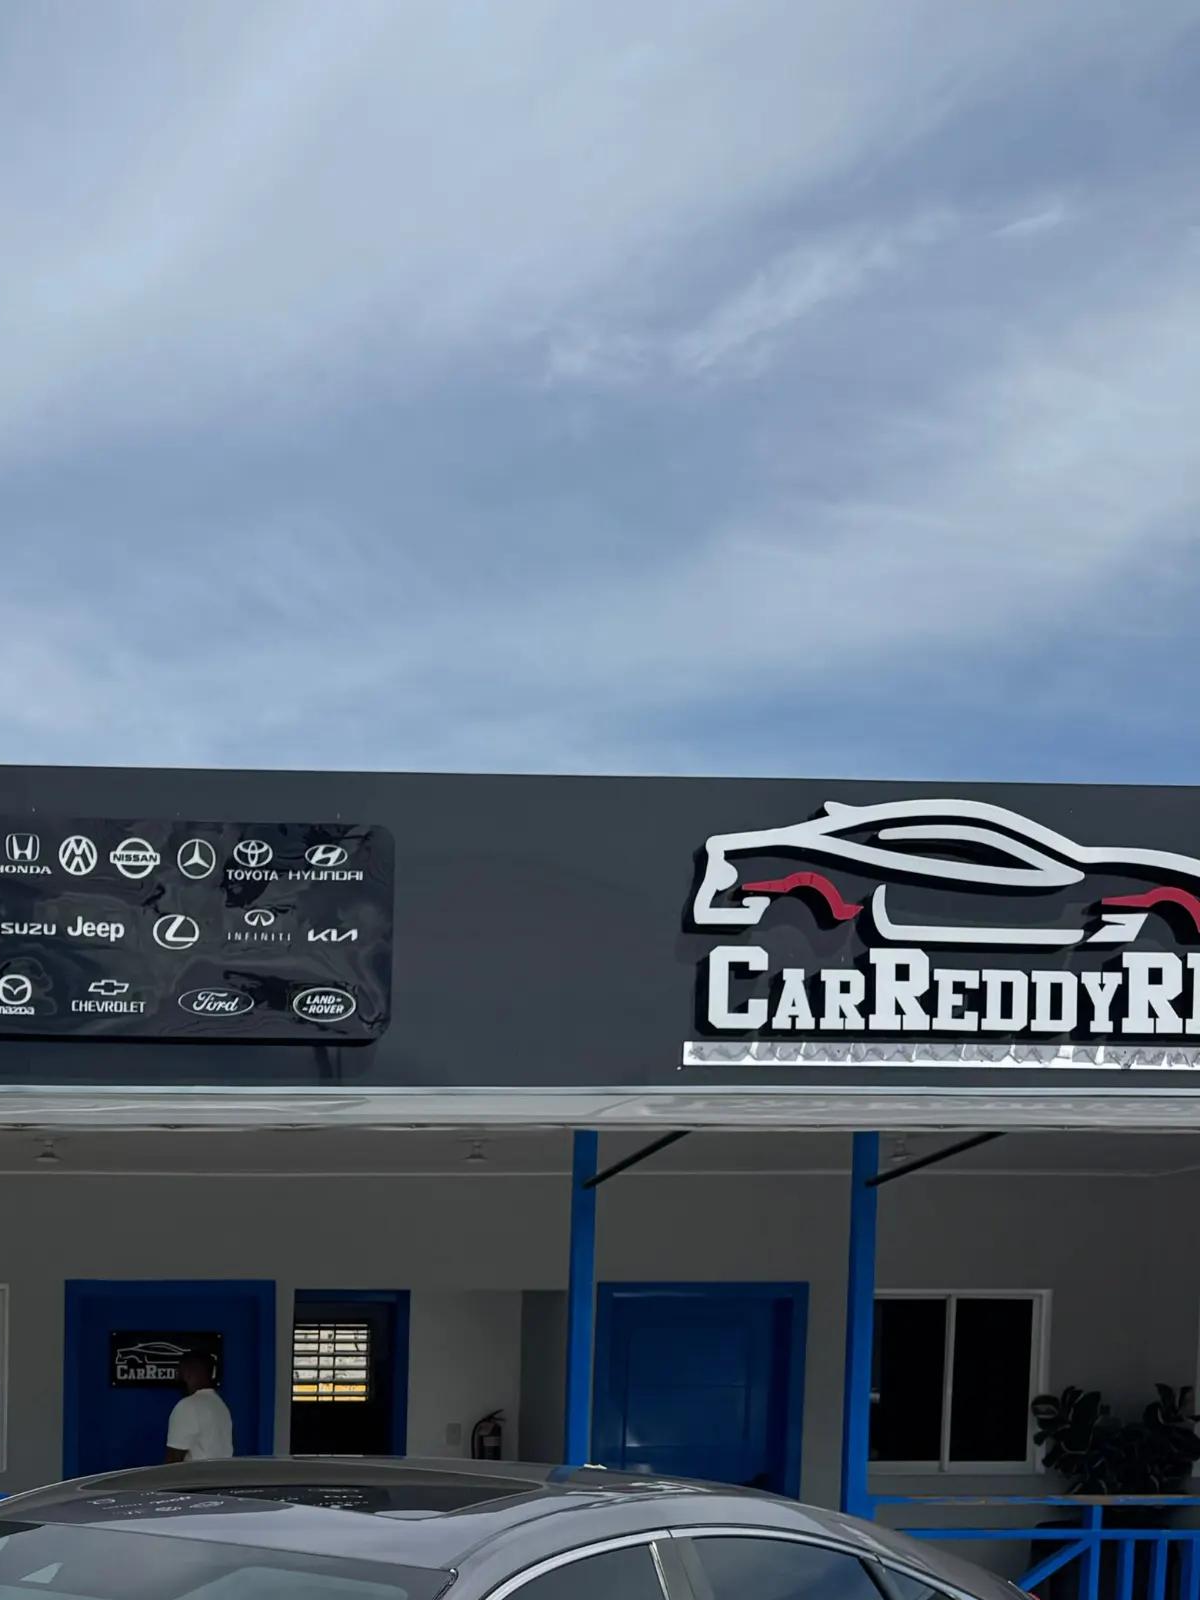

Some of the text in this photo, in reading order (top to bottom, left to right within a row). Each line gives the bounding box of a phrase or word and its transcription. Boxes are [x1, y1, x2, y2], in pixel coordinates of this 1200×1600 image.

[112, 853, 158, 863] NISSAN
[226, 869, 279, 881] TOYOTA
[288, 870, 364, 881] HYUNDAI
[67, 916, 125, 942] Jeep
[227, 931, 291, 941] INFINITI
[708, 946, 1200, 1035] CARREDDYR
[71, 999, 147, 1013] CHEVROLET
[192, 990, 240, 1012] Ford
